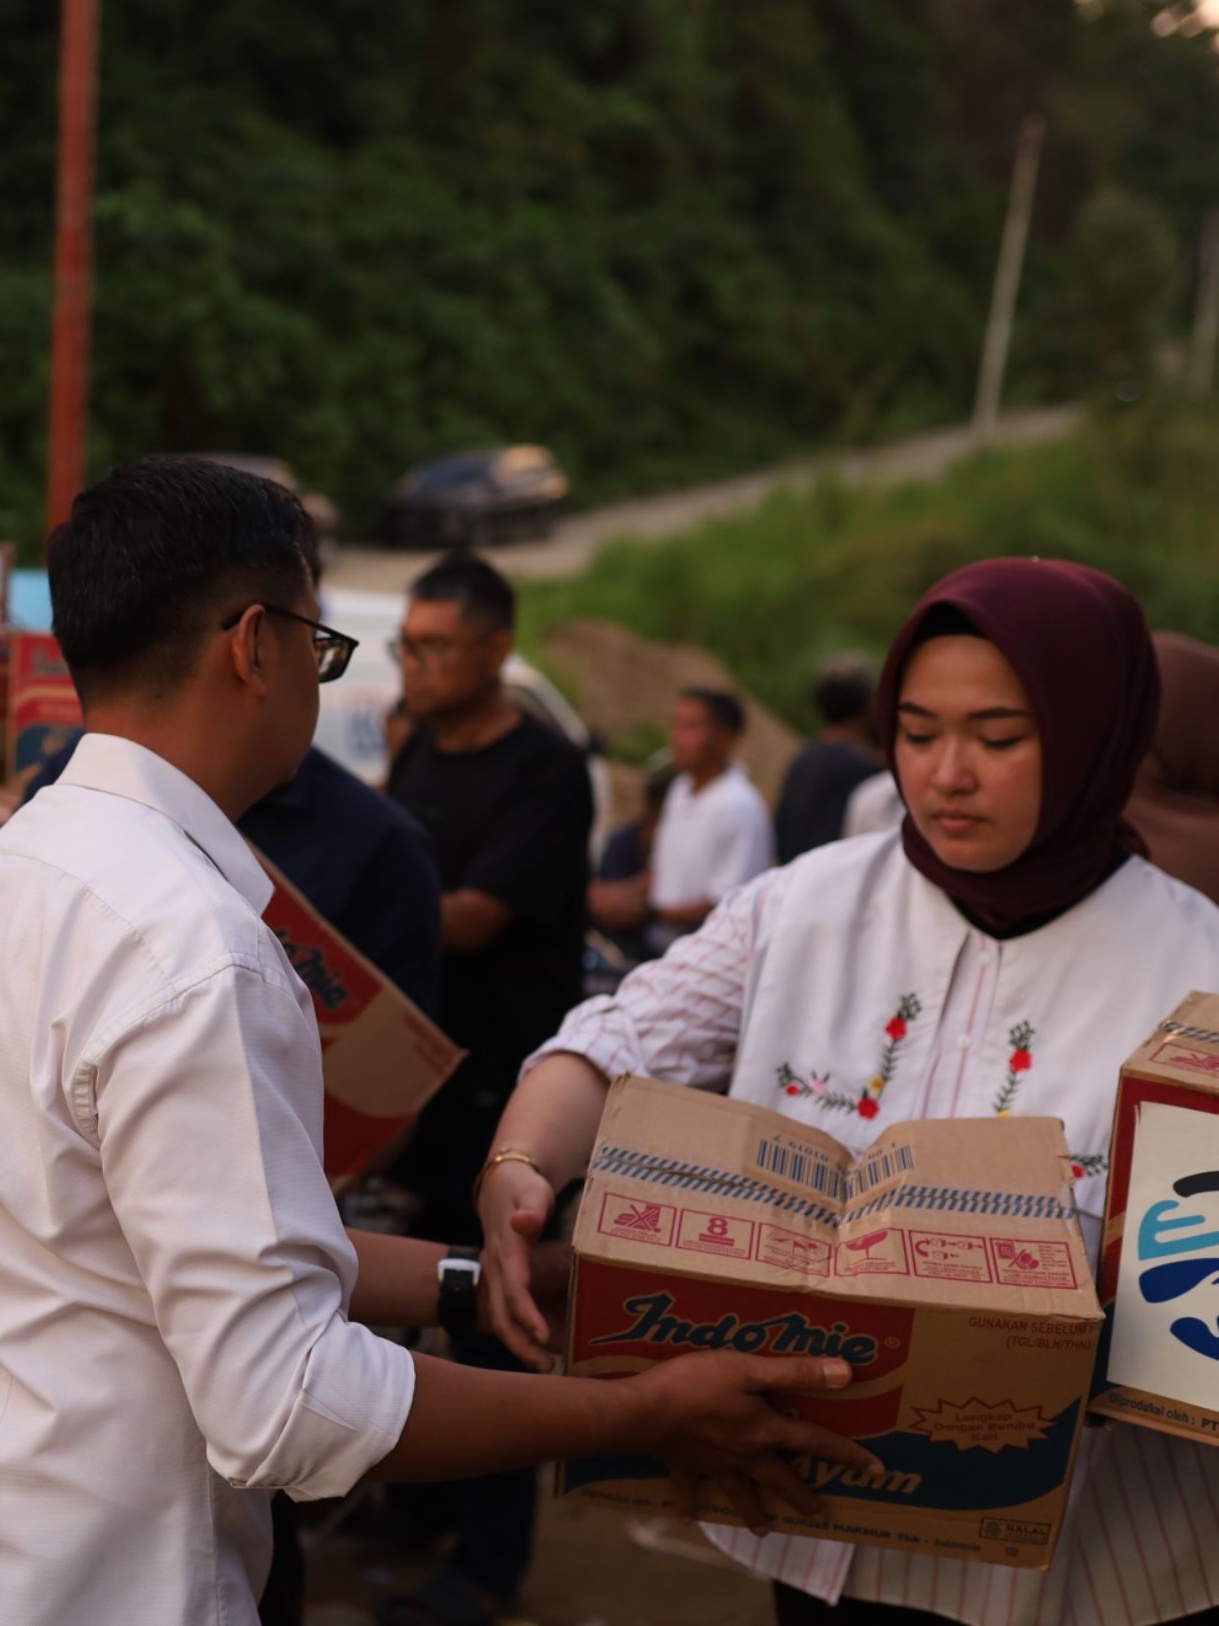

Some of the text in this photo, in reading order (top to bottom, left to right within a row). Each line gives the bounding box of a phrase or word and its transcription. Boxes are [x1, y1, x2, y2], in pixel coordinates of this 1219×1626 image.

[706, 1217, 730, 1237] 8
[968, 1316, 1028, 1332] GUNAKAN
[1166, 1408, 1189, 1424] oleh
[1006, 1523, 1046, 1536] HALAL
